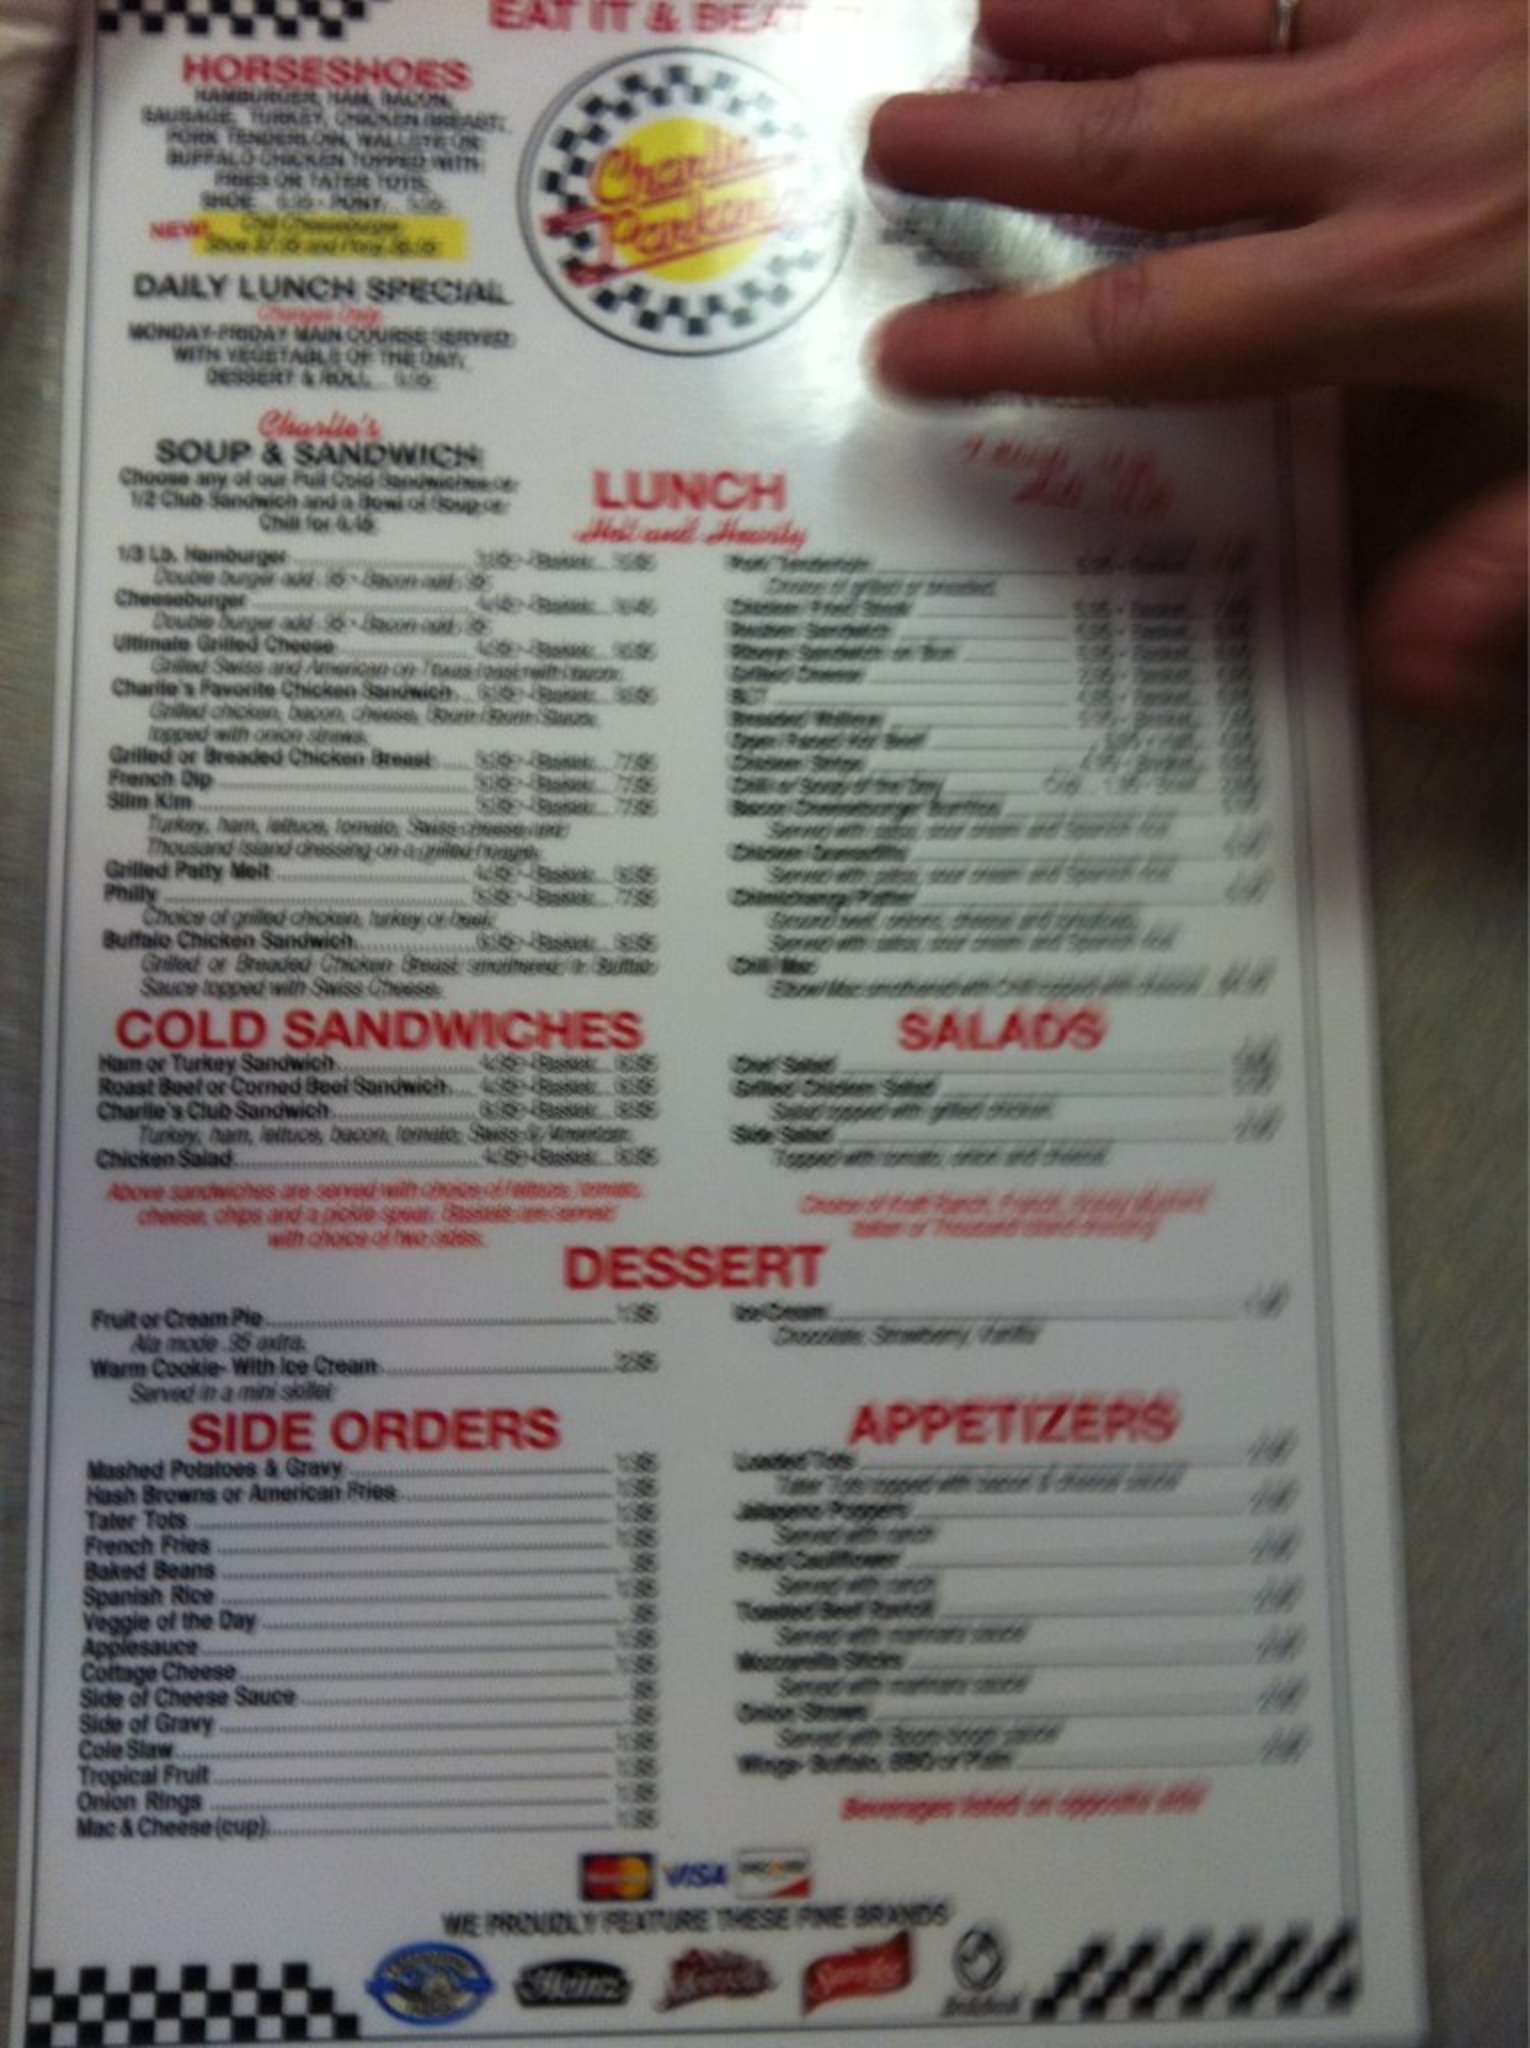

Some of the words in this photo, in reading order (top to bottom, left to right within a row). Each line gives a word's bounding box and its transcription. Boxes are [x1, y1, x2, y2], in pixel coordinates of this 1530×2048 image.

[182, 54, 472, 89] HORSESHOES
[133, 272, 229, 300] DAILY
[239, 273, 357, 302] LUNCH
[366, 276, 512, 306] SPECIAL
[294, 325, 343, 344] MAIN
[172, 345, 221, 364] WITH
[227, 346, 339, 366] VEGETABLE
[346, 349, 374, 366] OF
[206, 367, 294, 388] DESSERT
[256, 408, 382, 441] Charlie's
[154, 438, 251, 466] SOUP
[260, 441, 283, 467] &
[293, 441, 483, 469] SANDWICH
[118, 467, 190, 488] Choose
[194, 471, 228, 491] any
[233, 468, 252, 488] of
[257, 473, 288, 489] our
[592, 469, 787, 511] LUNCH
[161, 490, 203, 510] Club
[208, 491, 298, 510] Sandwich
[304, 513, 331, 532] for
[184, 547, 288, 568] Hamburger
[153, 570, 214, 589] Double
[219, 571, 275, 592] burger
[114, 590, 247, 612] Cheeseburger
[113, 635, 190, 654] Ultimate
[196, 636, 259, 655] Grilled
[264, 637, 336, 656] Cheese
[150, 658, 208, 677] Grilled
[111, 679, 195, 700] Charlie's
[199, 680, 276, 700] Favorite
[281, 681, 358, 700] Chicken
[362, 681, 454, 701] Sandwich
[108, 745, 173, 766] Grilled
[177, 750, 197, 766] or
[204, 746, 282, 767] Breaded
[288, 747, 366, 768] Chicken
[371, 748, 432, 769] Breast
[107, 768, 175, 788] French
[181, 769, 213, 790] Dip
[107, 791, 149, 811] Slim
[155, 792, 194, 811] Kim
[105, 859, 169, 880] Grilled
[174, 860, 223, 883] Patty
[230, 862, 272, 881] Melt
[103, 883, 158, 905] Philly
[103, 929, 173, 951] Buffalo
[176, 930, 255, 951] Chicken
[261, 931, 355, 951] Sandwich
[116, 1009, 267, 1050] COLD
[284, 1009, 644, 1050] SANDWICHES
[899, 1003, 1107, 1051] SALADS
[98, 1053, 142, 1073] Ham
[146, 1056, 165, 1073] or
[170, 1053, 236, 1076] Turkey
[241, 1053, 335, 1073] Sandwich
[98, 1076, 154, 1098] Roast
[159, 1076, 203, 1097] Beef
[207, 1080, 227, 1097] or
[229, 1076, 302, 1097] Corned
[306, 1076, 348, 1097] Beef
[353, 1075, 448, 1096] Sandwich
[96, 1101, 182, 1121] Charlie's
[187, 1101, 232, 1120] Club
[234, 1101, 330, 1120] Sandwich
[96, 1150, 175, 1170] Chicken
[179, 1150, 233, 1169] Salad
[564, 1245, 828, 1291] DESSERT
[92, 1308, 137, 1330] Fruit
[140, 1313, 161, 1330] or
[164, 1308, 228, 1330] Cream
[232, 1307, 264, 1329] Pie
[91, 1358, 147, 1379] Warm
[231, 1356, 275, 1377] With
[280, 1356, 308, 1376] Ice
[314, 1354, 378, 1376] Cream
[130, 1382, 196, 1404] Served
[848, 1393, 1181, 1446] APPETIZERS
[188, 1411, 314, 1455] SIDE
[330, 1408, 561, 1453] ORDERS
[87, 1459, 166, 1481] Mashed
[171, 1459, 256, 1480] Potatoes
[264, 1459, 278, 1478] &
[285, 1458, 344, 1481] Gravy
[86, 1485, 136, 1506] Hash
[142, 1484, 217, 1505] Browns
[222, 1487, 243, 1503] or
[248, 1483, 342, 1503] American
[347, 1481, 398, 1502] Fries
[85, 1510, 137, 1531] Tater
[144, 1509, 188, 1530] Tots
[85, 1535, 154, 1556] French
[161, 1534, 211, 1554] Fries
[84, 1560, 146, 1581] Baked
[153, 1560, 215, 1581] Beans
[82, 1586, 163, 1609] Spanish
[170, 1585, 215, 1605] Rice
[83, 1612, 150, 1636] Veggie
[156, 1611, 177, 1631] of
[182, 1610, 213, 1631] the
[219, 1610, 257, 1633] Day
[82, 1637, 198, 1660] Applesauce
[80, 1662, 158, 1686] Cottage
[161, 1662, 237, 1683] Cheese
[80, 1687, 124, 1709] Side
[129, 1687, 149, 1708] of
[154, 1686, 229, 1707] Cheese
[234, 1685, 297, 1707] Sauce
[79, 1713, 124, 1735] Side
[129, 1713, 149, 1733] of
[155, 1712, 215, 1737] Gravy
[78, 1739, 124, 1761] Cole
[126, 1738, 174, 1760] Slaw
[78, 1765, 158, 1789] Tropical
[163, 1764, 210, 1785] Fruit
[77, 1790, 137, 1813] Onion
[145, 1790, 203, 1815] Rings
[77, 1818, 116, 1839] Mac
[120, 1818, 133, 1837] &
[137, 1817, 213, 1838] Cheese
[216, 1814, 268, 1841] (cup)
[665, 1862, 728, 1888] VISA
[442, 1911, 478, 1936] WE
[485, 1911, 593, 1935] PROUDLY
[602, 1910, 709, 1932] FEATURE
[716, 1908, 790, 1930] THESE
[854, 1902, 950, 1927] BRANDS
